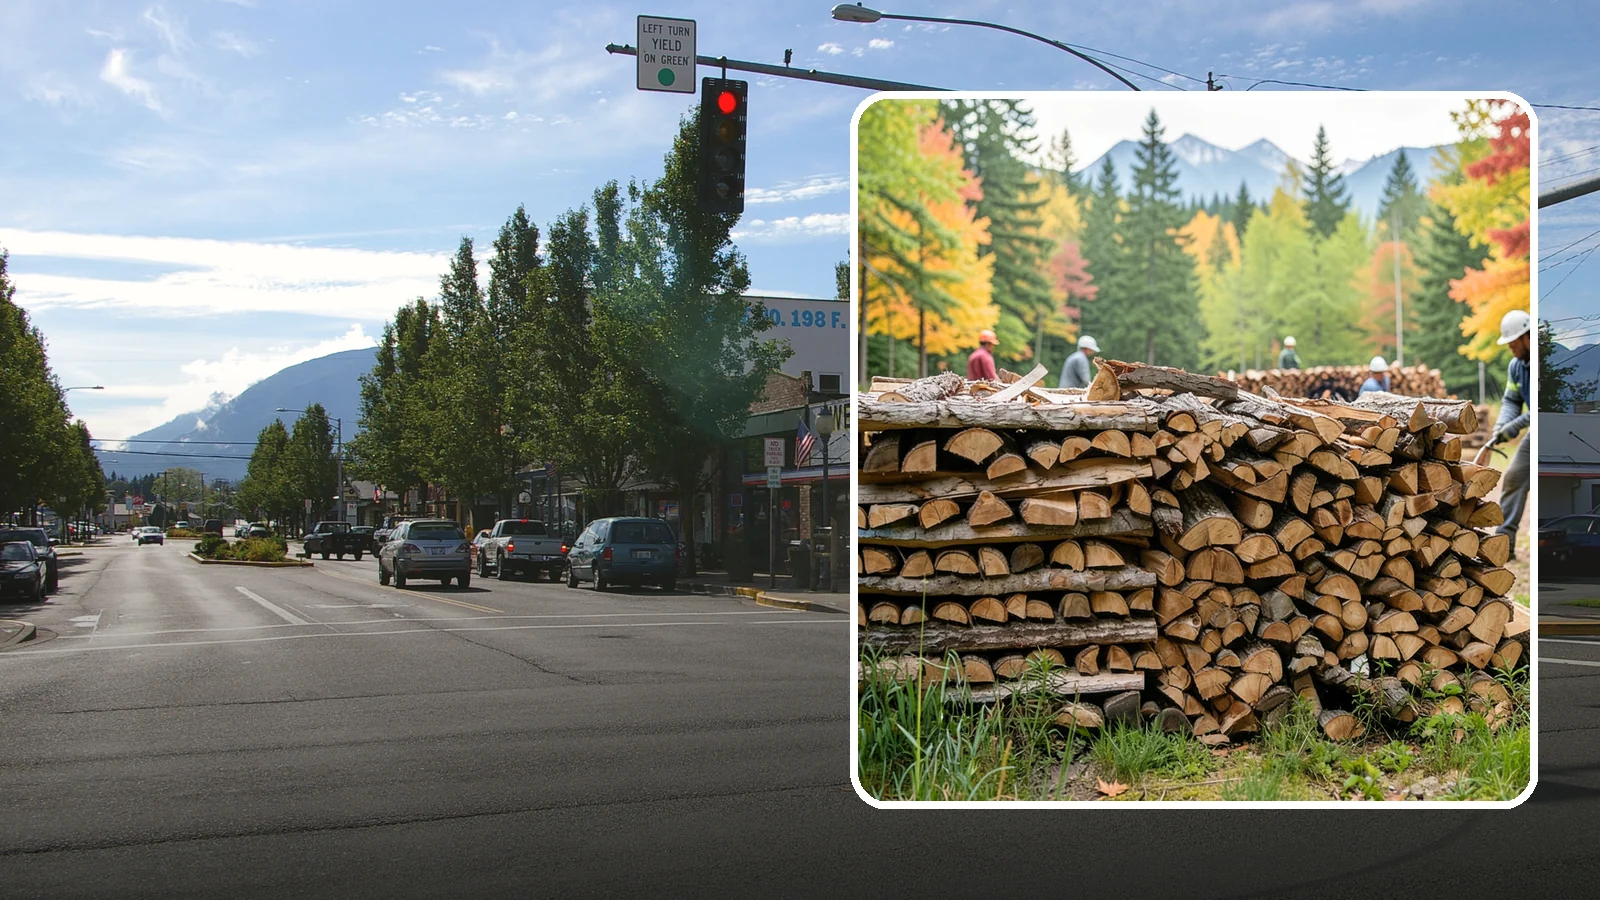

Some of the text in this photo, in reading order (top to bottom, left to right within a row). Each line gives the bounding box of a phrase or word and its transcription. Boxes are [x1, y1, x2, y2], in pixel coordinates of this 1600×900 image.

[643, 24, 690, 36] LEFT TURN
[652, 38, 682, 52] YIELD
[644, 53, 689, 66] ON GREEN
[791, 309, 826, 328] 198
[831, 311, 847, 329] F.
